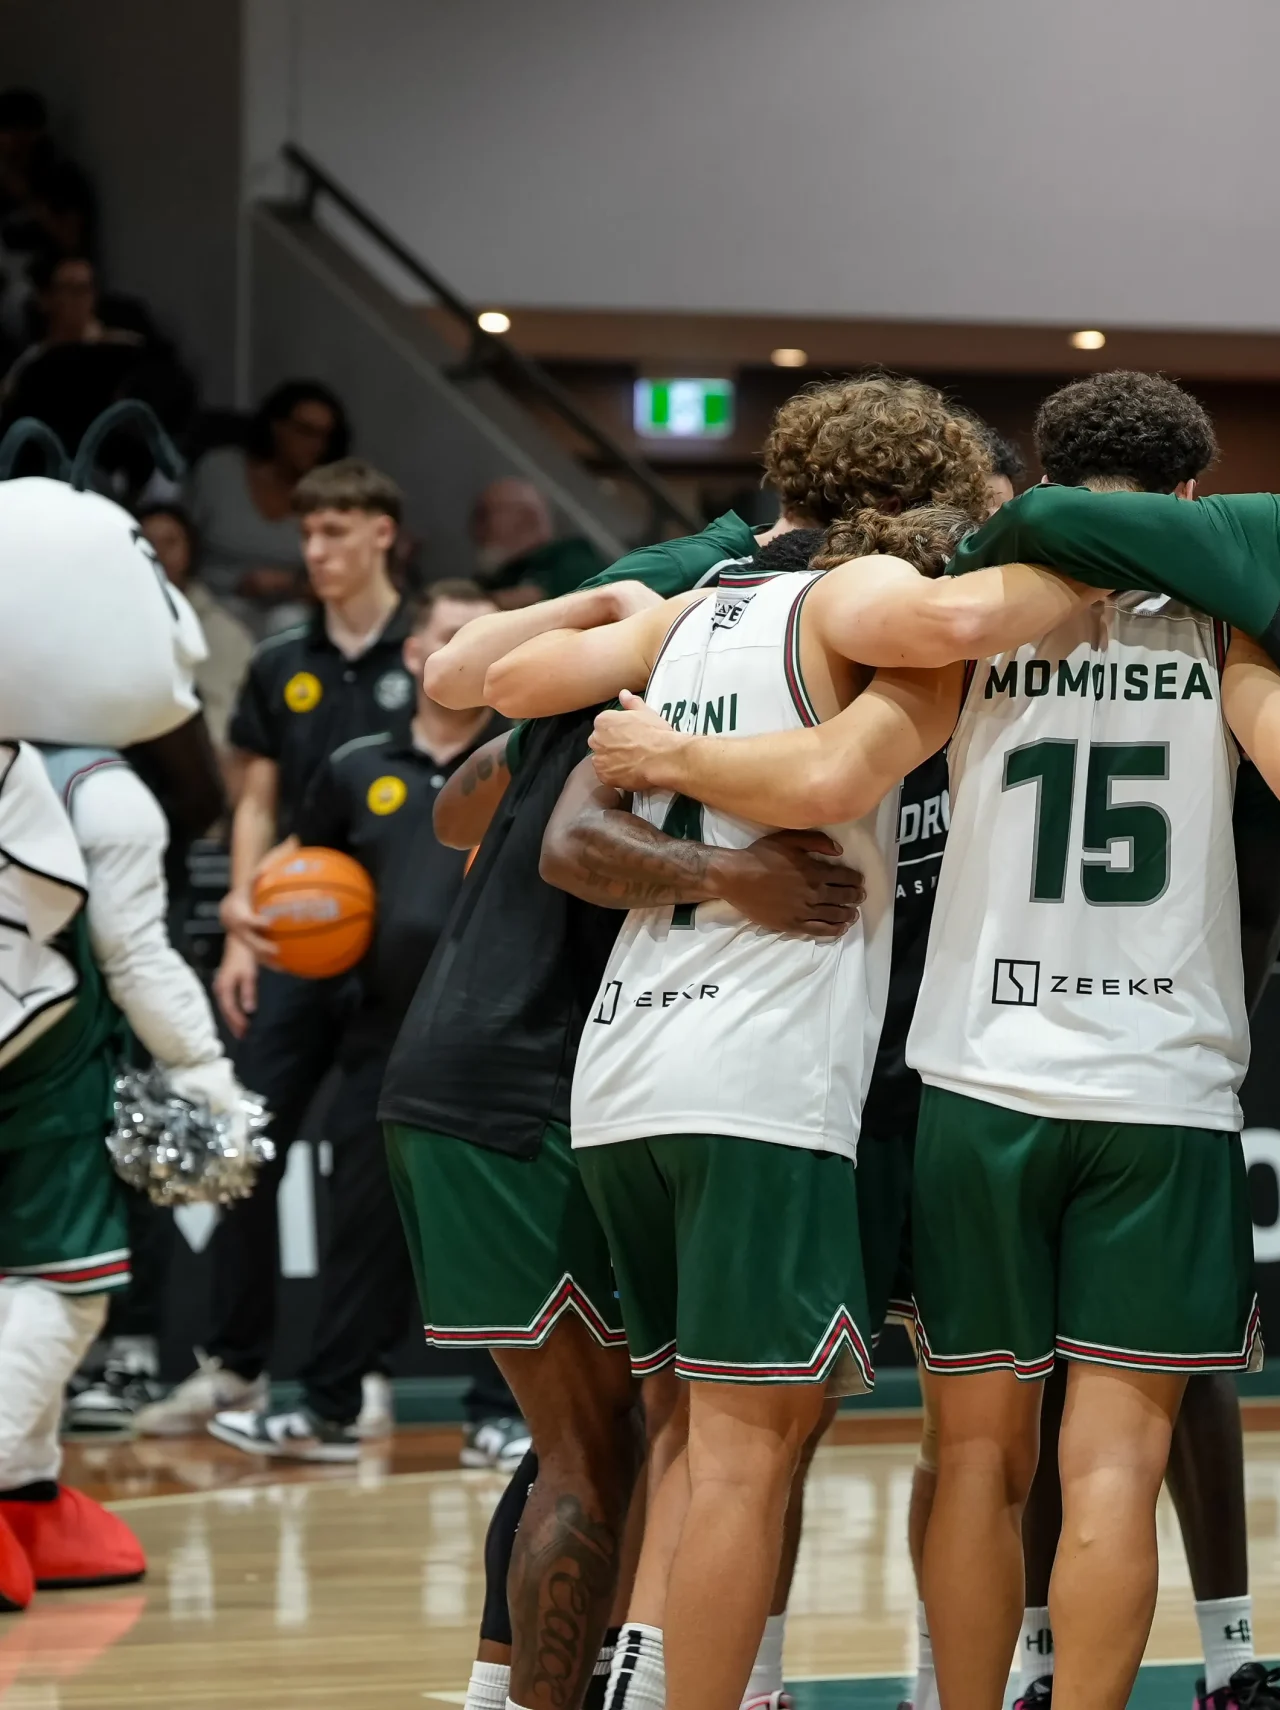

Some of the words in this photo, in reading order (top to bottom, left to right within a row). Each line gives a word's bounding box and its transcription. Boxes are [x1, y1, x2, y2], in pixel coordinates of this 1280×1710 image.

[984, 660, 1213, 701] MOMOISEA
[1001, 737, 1172, 907] 15
[1051, 976, 1174, 996] ZEEKR
